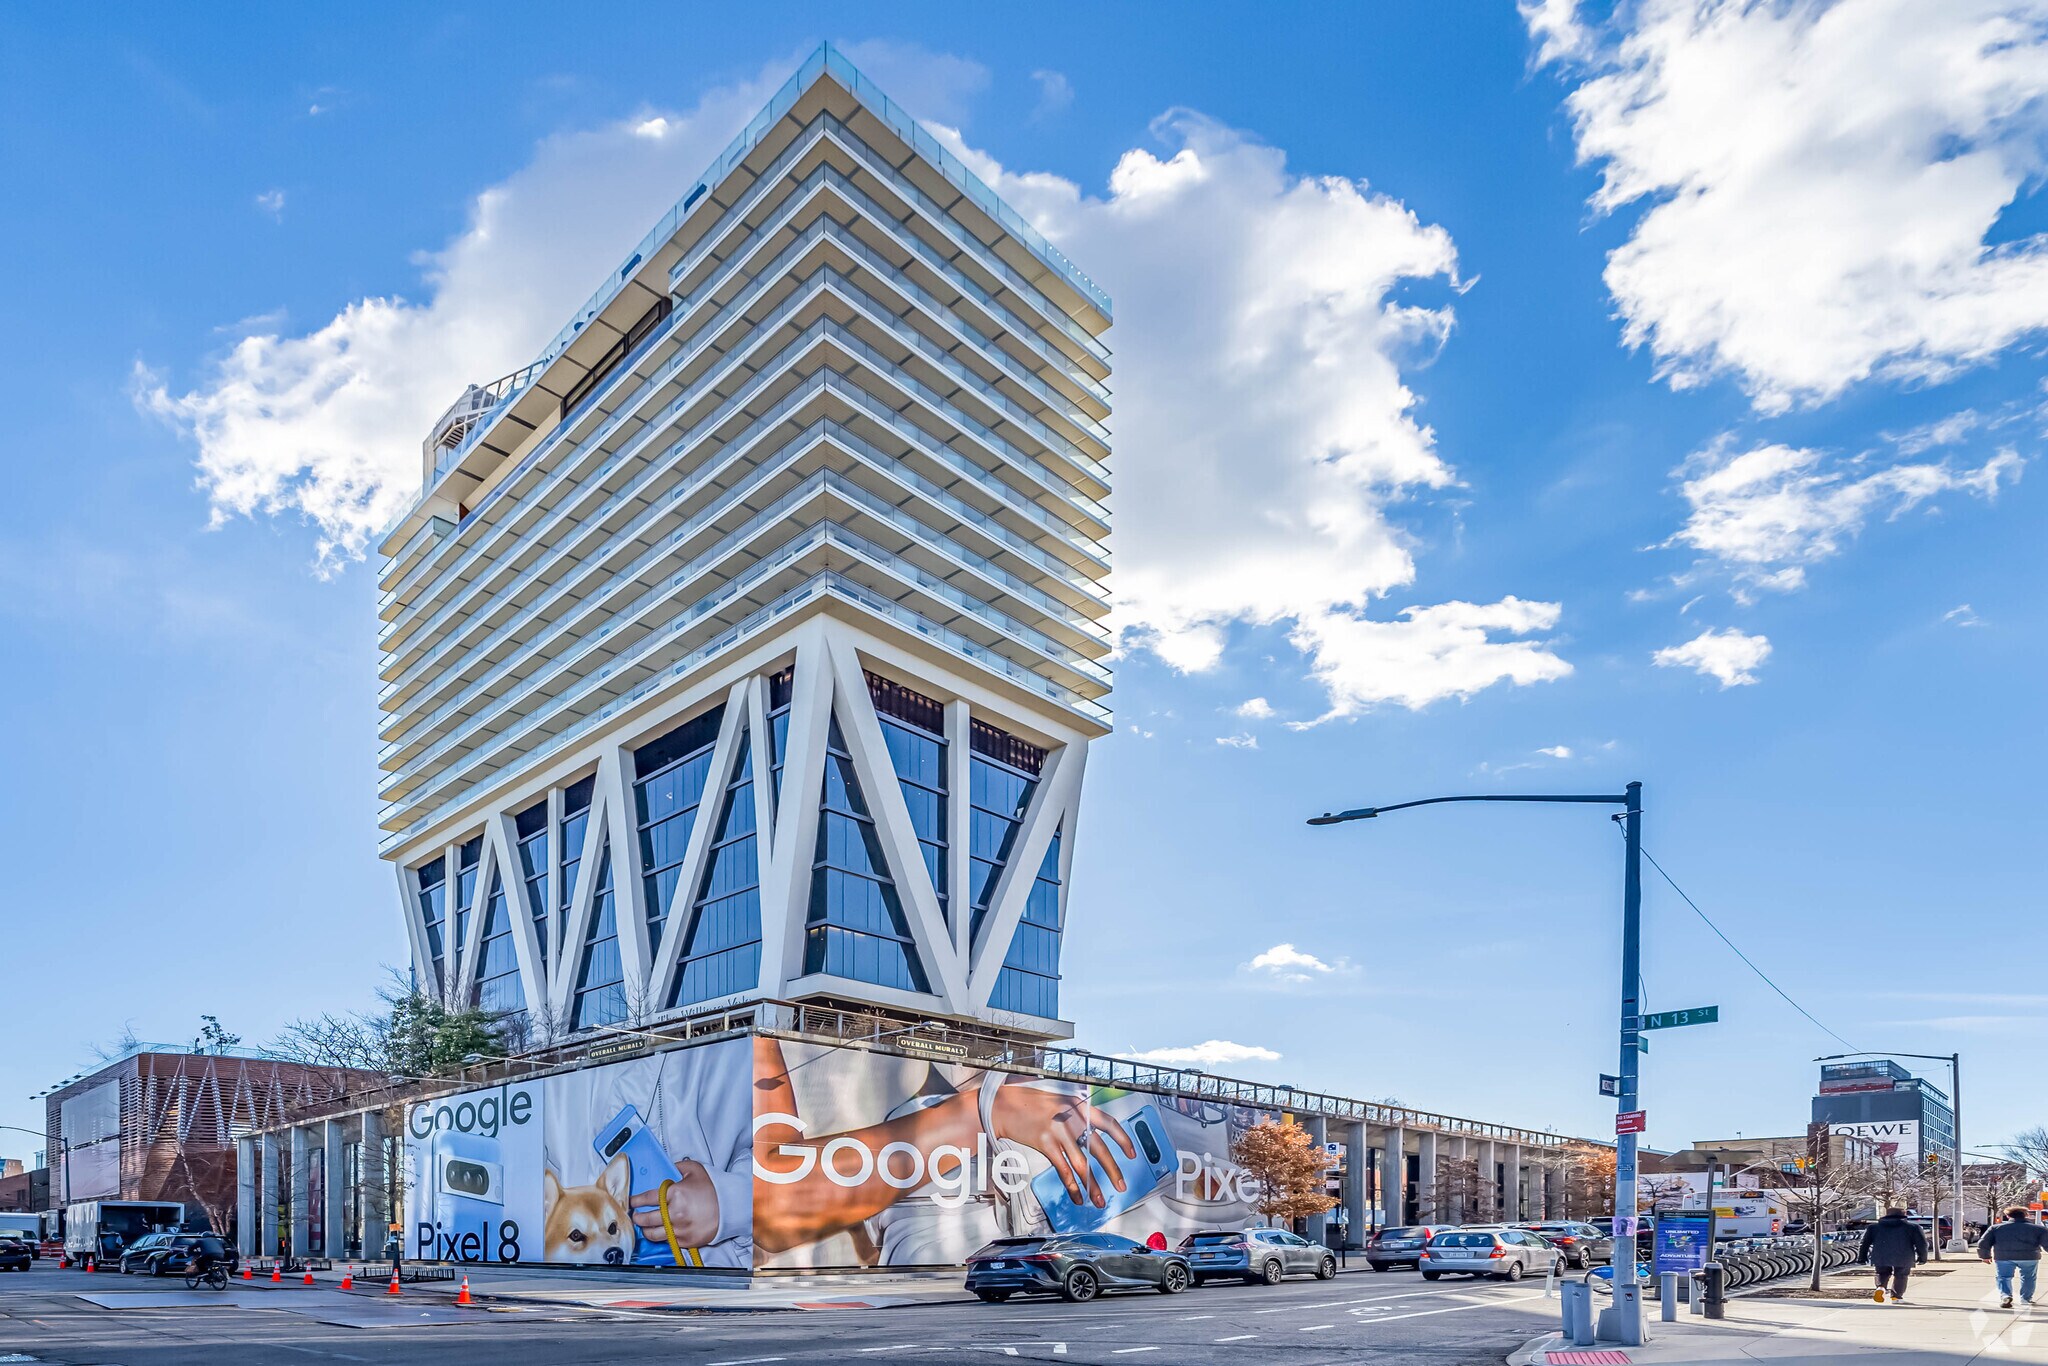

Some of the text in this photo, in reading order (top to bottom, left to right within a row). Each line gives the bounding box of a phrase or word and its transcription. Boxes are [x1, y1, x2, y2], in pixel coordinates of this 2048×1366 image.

[1651, 1008, 1710, 1028] N 13 St
[590, 1041, 644, 1058] OVERALL MURALS
[901, 1039, 964, 1055] OVERALL MURALS
[409, 1086, 532, 1139] Google
[1835, 1123, 1912, 1137] OEWE
[753, 1112, 1030, 1209] Google
[1176, 1150, 1261, 1204] Pixe
[418, 1219, 520, 1262] Pixel 8
